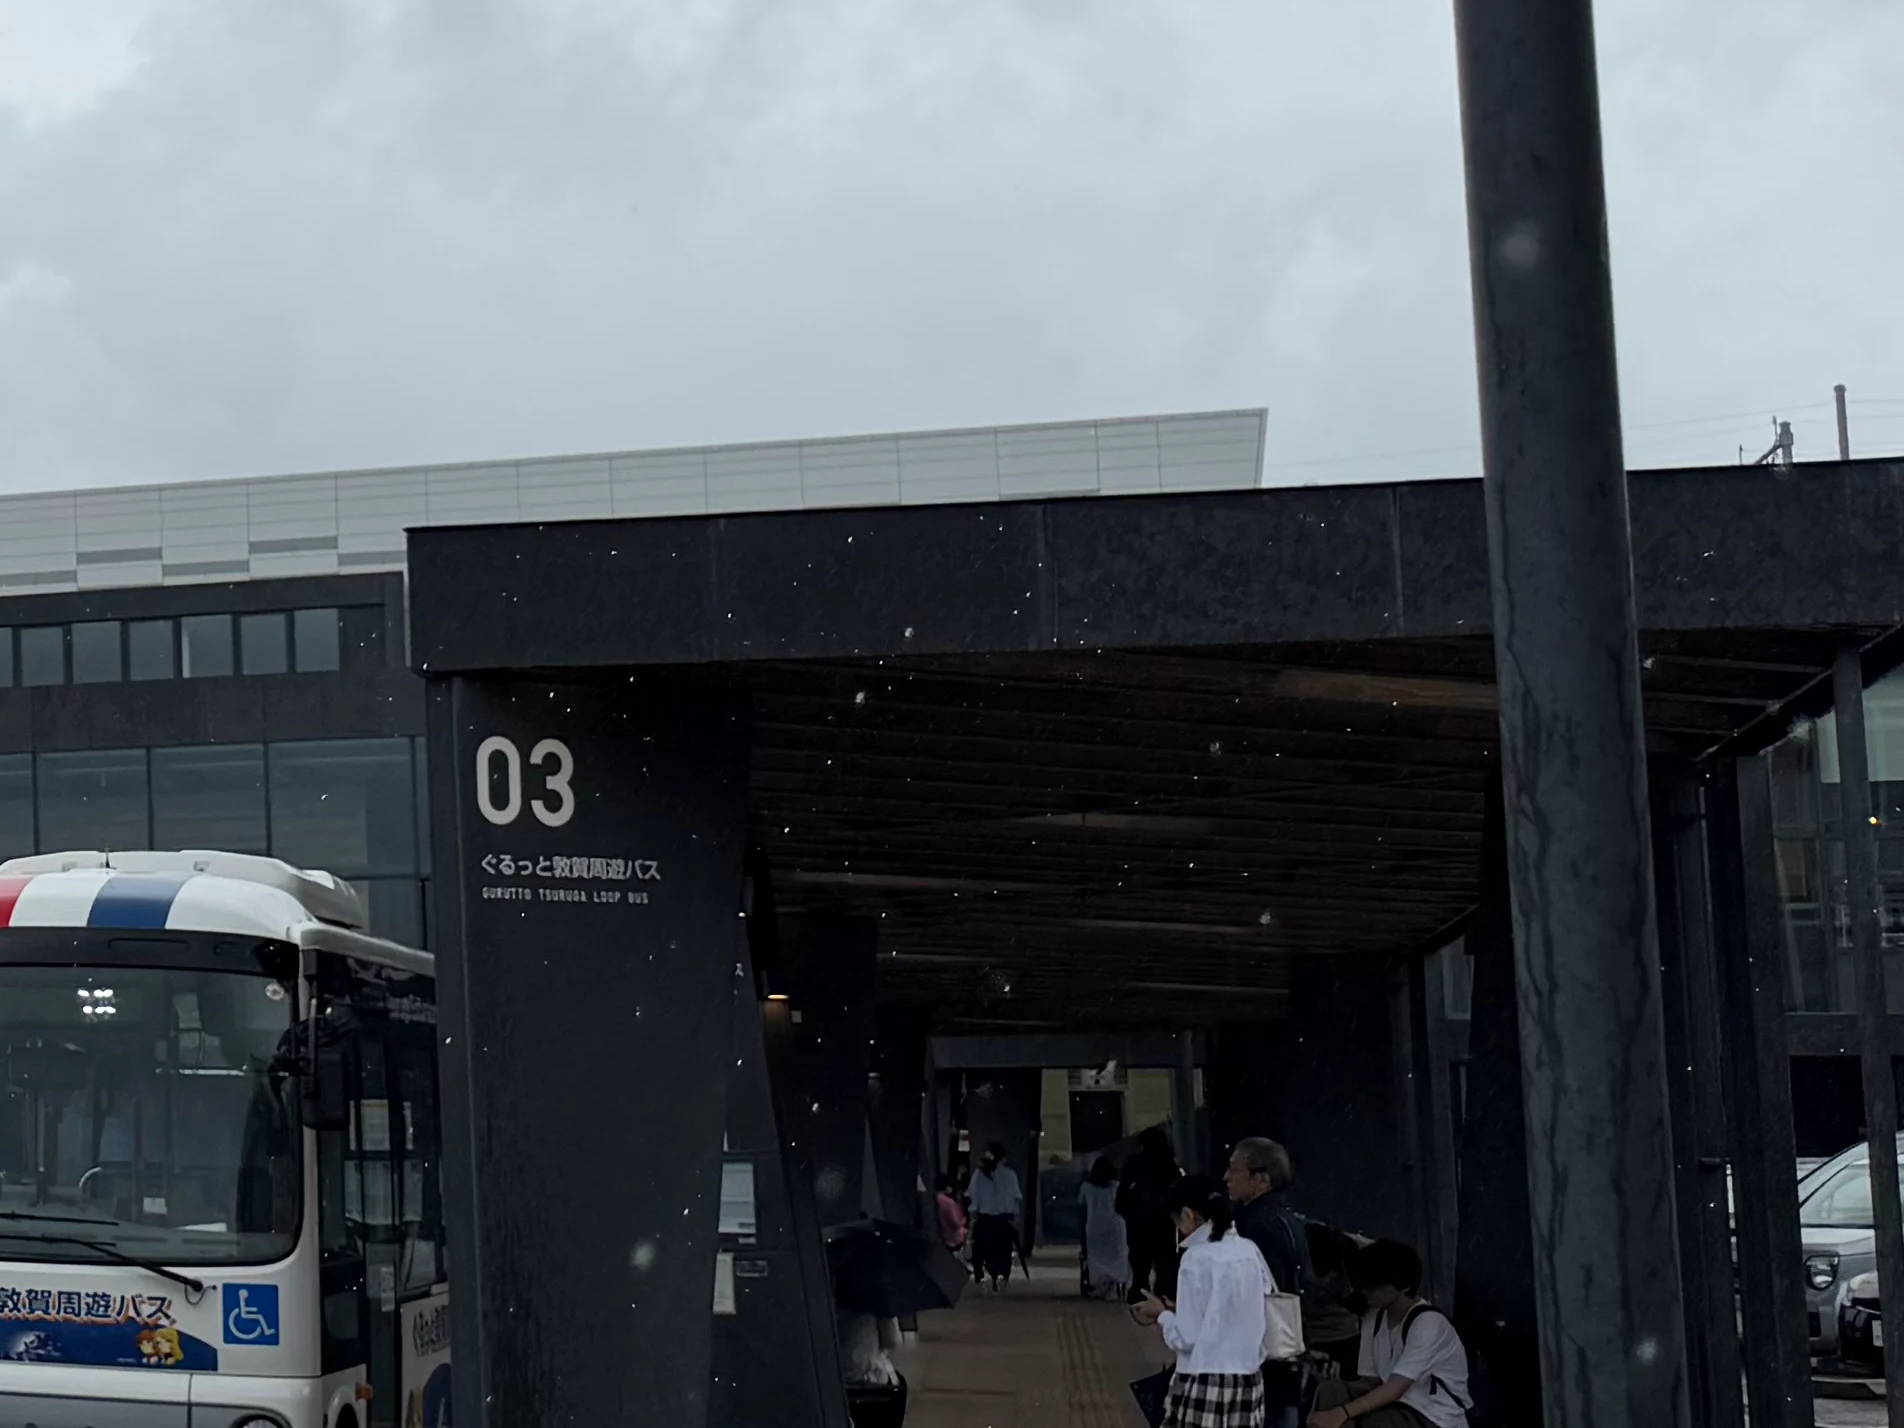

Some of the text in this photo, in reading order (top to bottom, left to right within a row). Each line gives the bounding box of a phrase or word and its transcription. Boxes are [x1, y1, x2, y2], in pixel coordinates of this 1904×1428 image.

[476, 736, 575, 827] 03
[481, 853, 661, 881] ぐるっと敦賀周遊バス
